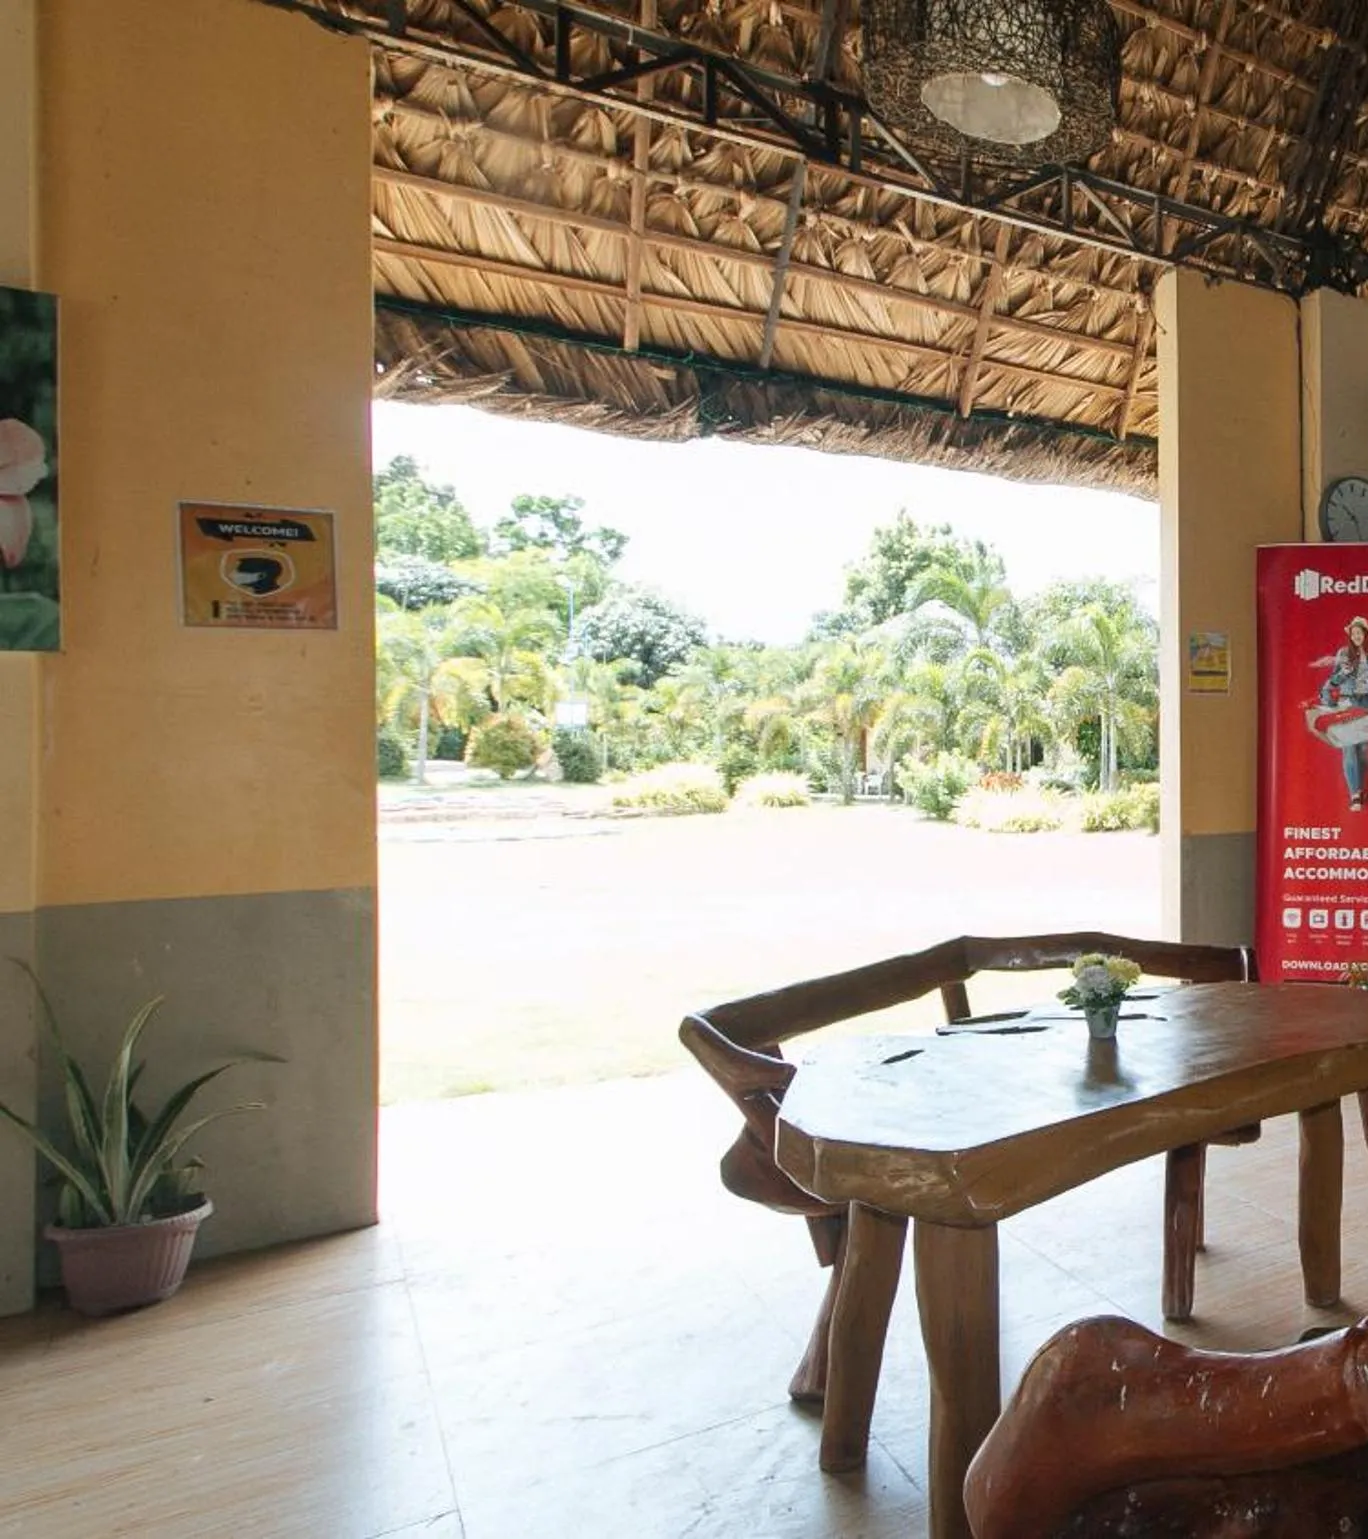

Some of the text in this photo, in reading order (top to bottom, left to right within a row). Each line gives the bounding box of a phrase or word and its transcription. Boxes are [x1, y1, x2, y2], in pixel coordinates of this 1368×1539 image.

[218, 523, 299, 537] WELCOME!
[1283, 827, 1342, 840] FINEST
[1283, 893, 1338, 904] Guaranteed
[1281, 959, 1349, 971] DOWNLOAD
